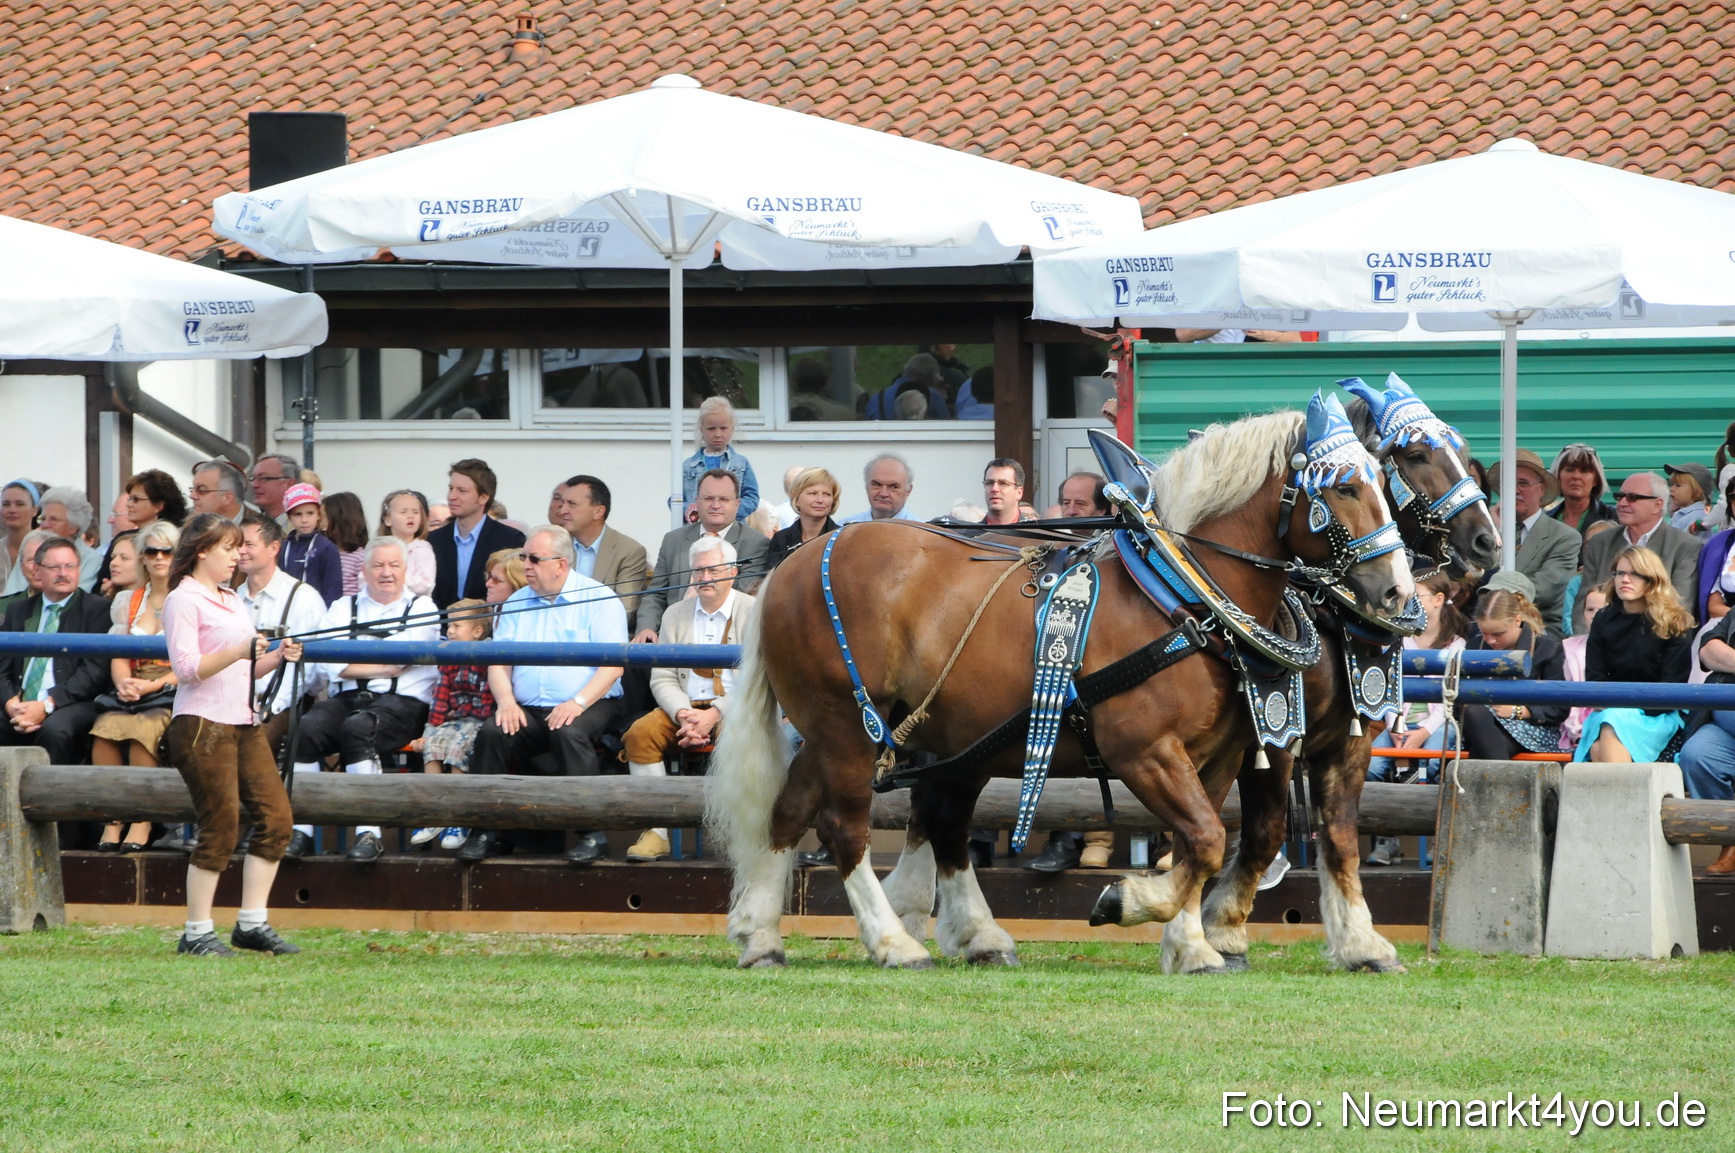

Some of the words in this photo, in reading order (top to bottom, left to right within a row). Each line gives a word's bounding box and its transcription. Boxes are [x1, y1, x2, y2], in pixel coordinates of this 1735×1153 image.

[419, 198, 524, 215] GANSBRÄU
[747, 197, 862, 212] GANSBRÄU
[446, 230, 471, 240] guter
[471, 224, 512, 238] Schluck
[789, 219, 855, 234] Neumarkt's
[1106, 257, 1174, 273] GANSBRÄU
[1366, 252, 1492, 268] GANSBRÄU
[1137, 279, 1173, 294] Neumarkt's
[1410, 275, 1481, 291] Neumarkt's
[1405, 290, 1435, 303] guter
[1436, 289, 1486, 303] Schluck
[184, 301, 255, 315] GANSBRÄU
